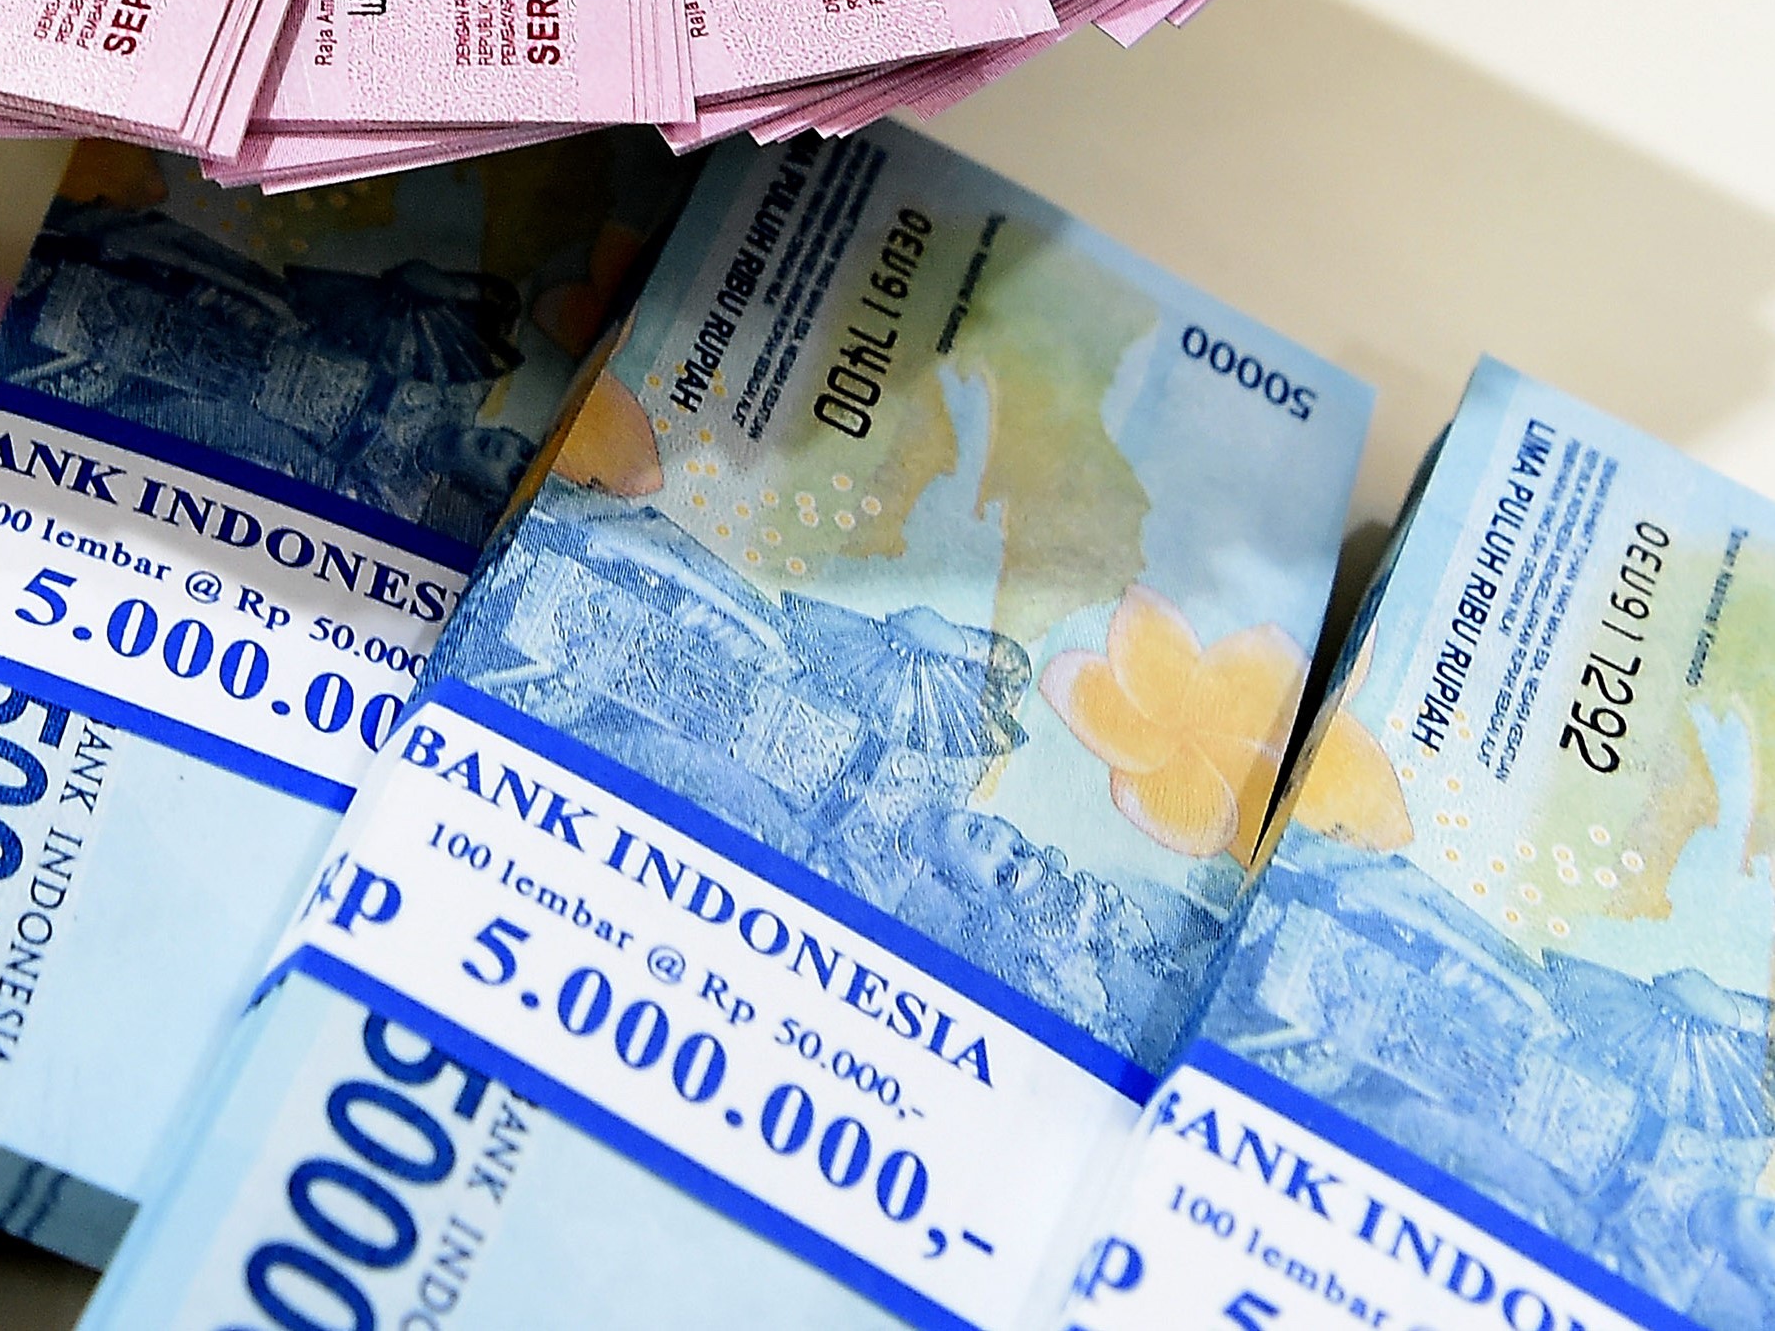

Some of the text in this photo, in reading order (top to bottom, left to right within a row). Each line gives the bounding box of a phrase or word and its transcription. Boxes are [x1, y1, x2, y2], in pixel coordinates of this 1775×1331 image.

[314, 28, 339, 66] Raja
[683, 0, 710, 39] Raja
[745, 163, 808, 254] PULUH
[716, 246, 766, 318] RIBU
[669, 308, 737, 414] RUPIAH
[1180, 324, 1317, 422] 50000
[41, 517, 172, 581] lembar
[184, 569, 223, 606] @
[236, 587, 291, 631] Rp
[132, 475, 460, 622] INDONES
[1411, 418, 1556, 753] LIMA PULUH RIBU RUPIAH
[59, 716, 120, 815] ANK
[400, 724, 993, 1088] BANK INDONESIA
[429, 823, 924, 1119] 100 lembar @ Rp 50.000,-
[427, 916, 994, 1258] 5.000.000,-
[229, 1012, 488, 1331] 5000
[467, 1089, 547, 1204] ANK
[1071, 1236, 1145, 1299] p
[1170, 1185, 1390, 1330] 100 lembar
[1356, 1197, 1584, 1331] INDO
